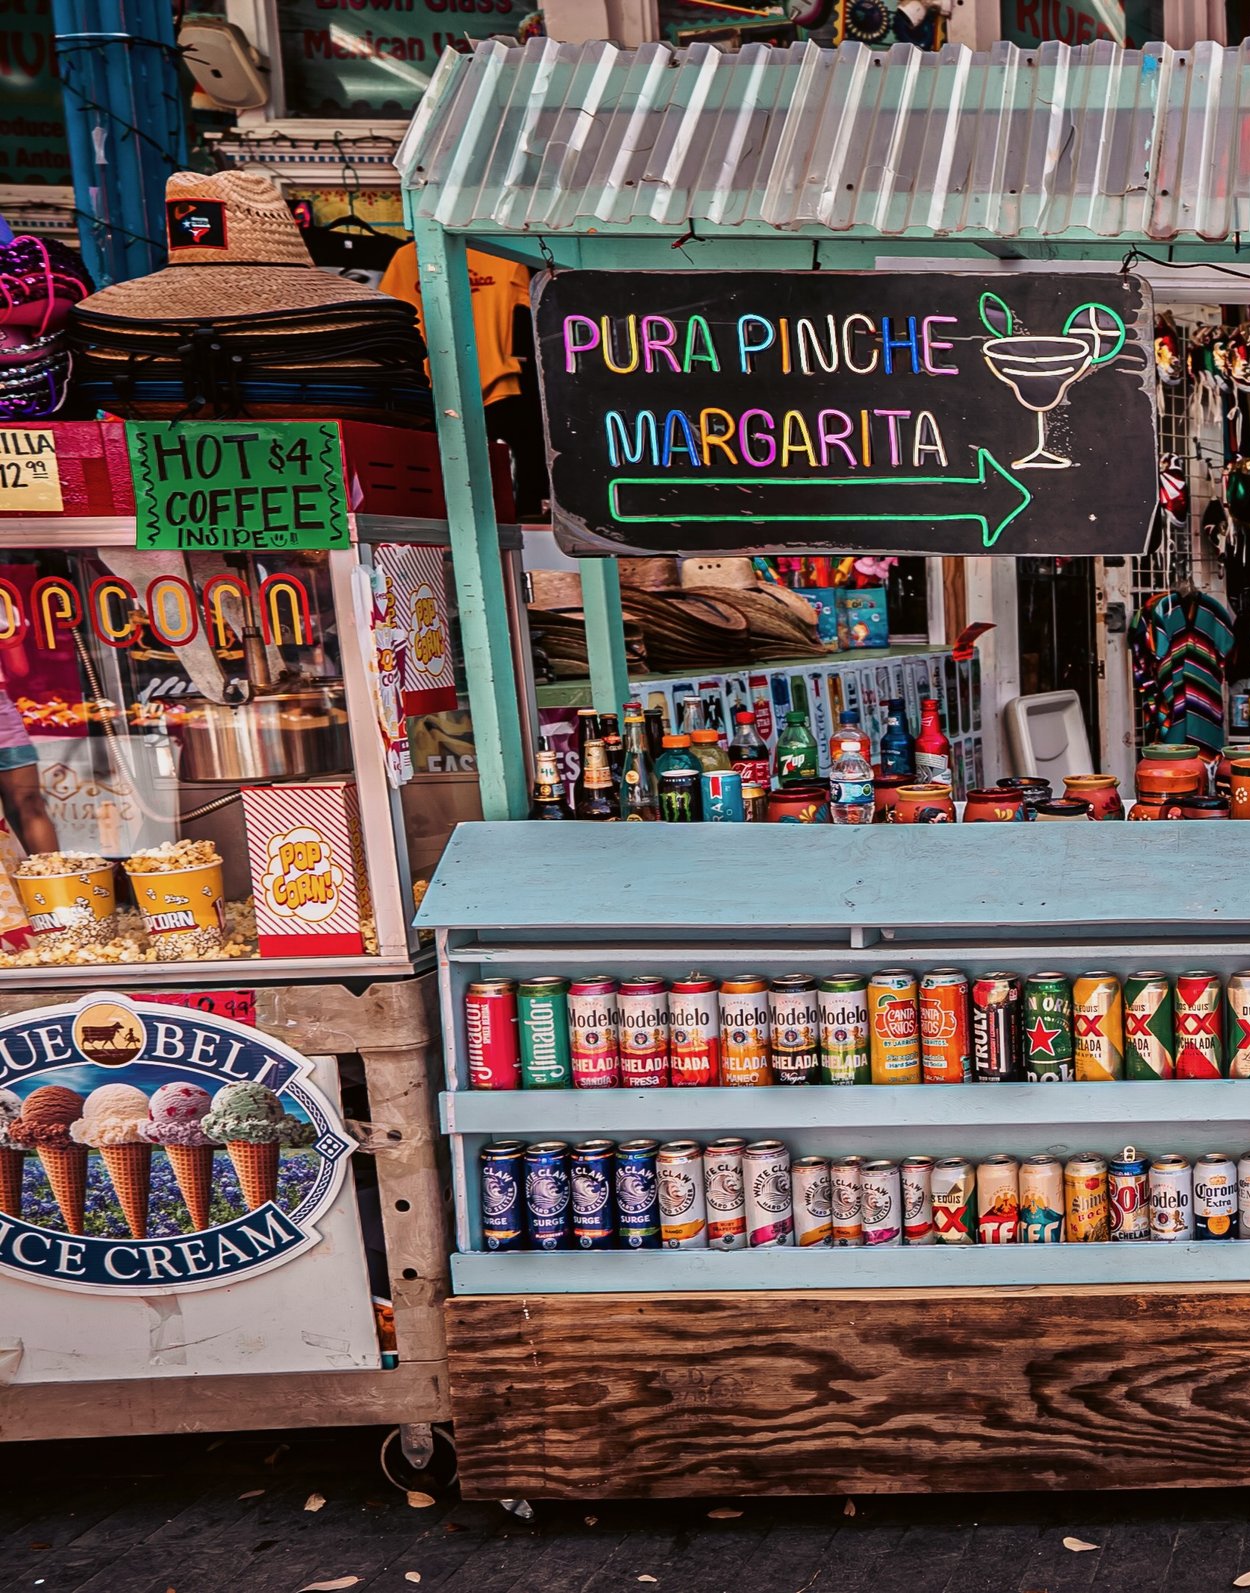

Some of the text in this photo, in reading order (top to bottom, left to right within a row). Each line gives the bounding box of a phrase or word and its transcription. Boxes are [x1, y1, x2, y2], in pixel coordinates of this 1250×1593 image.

[564, 312, 960, 375] PURA PINCHE
[605, 407, 950, 468] MARGARITA
[155, 432, 313, 483] HOT $4
[165, 483, 326, 534] COFFEE
[177, 525, 270, 549] INSIDE
[278, 841, 323, 875] POP
[272, 870, 335, 910] CORN!
[523, 998, 565, 1079] jimador
[973, 1007, 991, 1072] TRULY
[151, 1022, 283, 1092] BELL
[576, 1166, 606, 1183] CLAW
[661, 1169, 693, 1184] CLAW
[753, 1168, 771, 1199] WHITE
[863, 1183, 889, 1197] CLAW
[804, 1181, 819, 1206] WHITE
[936, 1194, 962, 1205] EQUIS
[1194, 1182, 1238, 1199] Corona
[1205, 1197, 1232, 1208] Extra
[532, 1217, 566, 1228] SURGE
[619, 1214, 651, 1224] SURGE
[104, 1210, 296, 1281] CREAM
